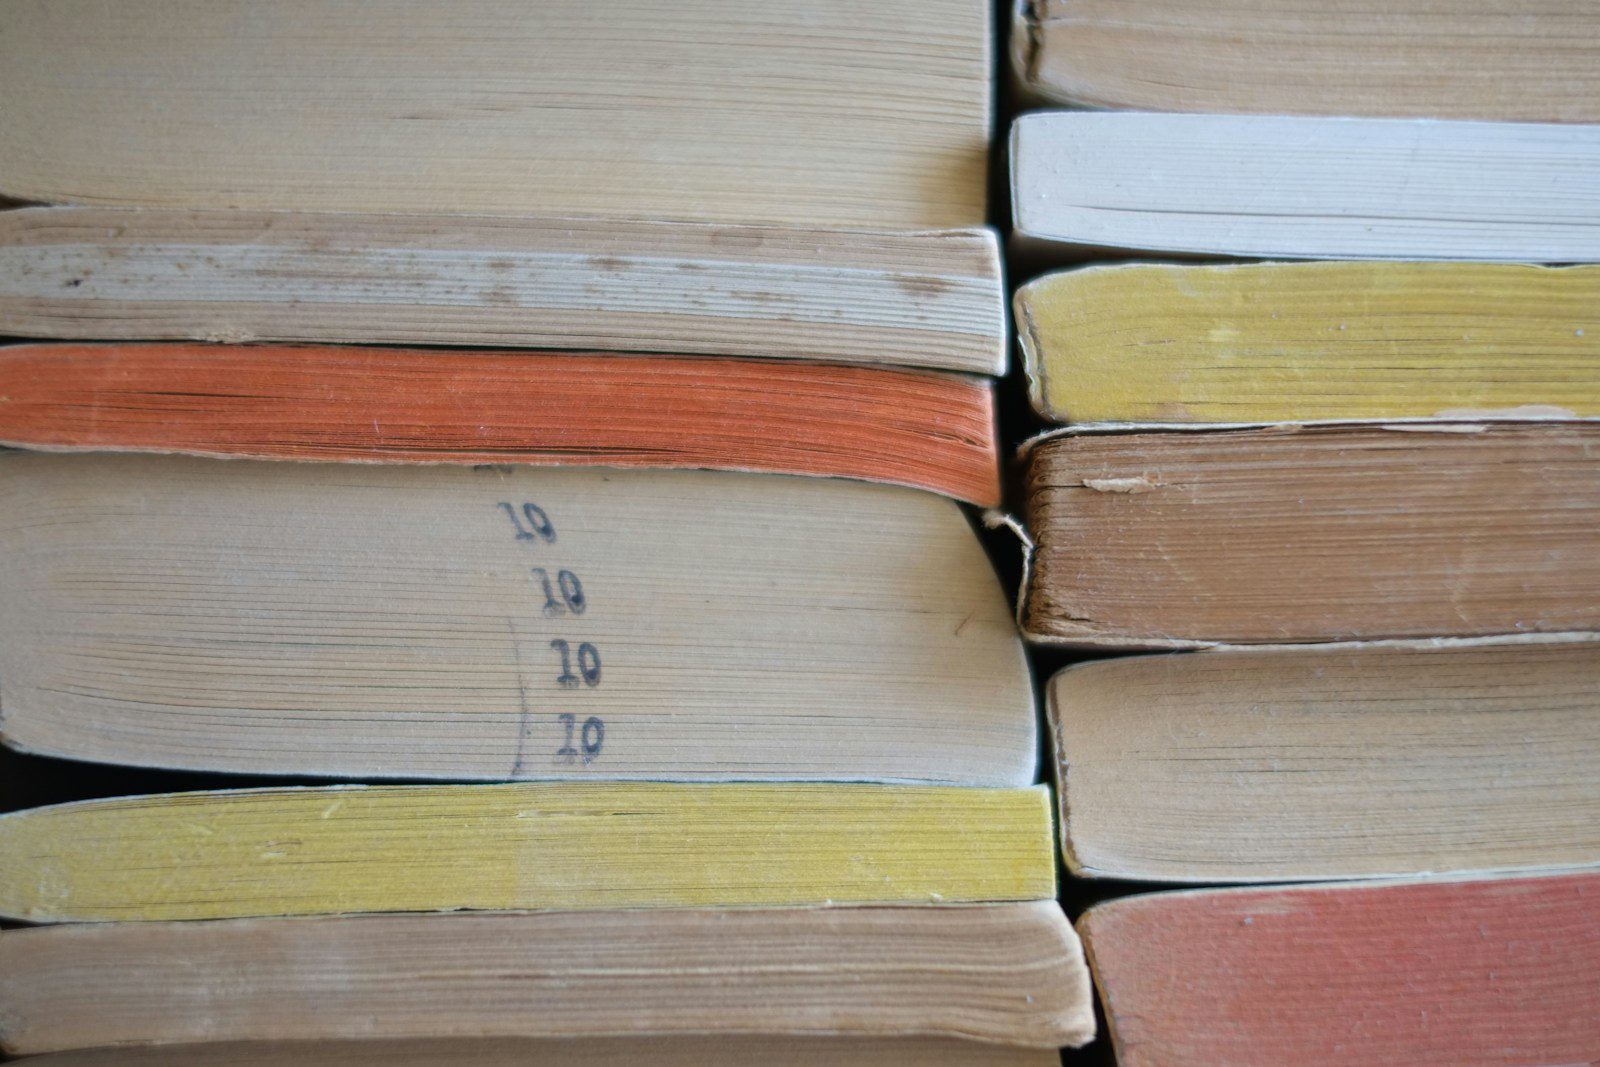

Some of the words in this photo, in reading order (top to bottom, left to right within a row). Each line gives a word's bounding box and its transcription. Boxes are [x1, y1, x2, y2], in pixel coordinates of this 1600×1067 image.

[498, 502, 557, 543] 10
[532, 567, 587, 616] 10
[551, 639, 602, 688] 10
[554, 713, 605, 766] 10
